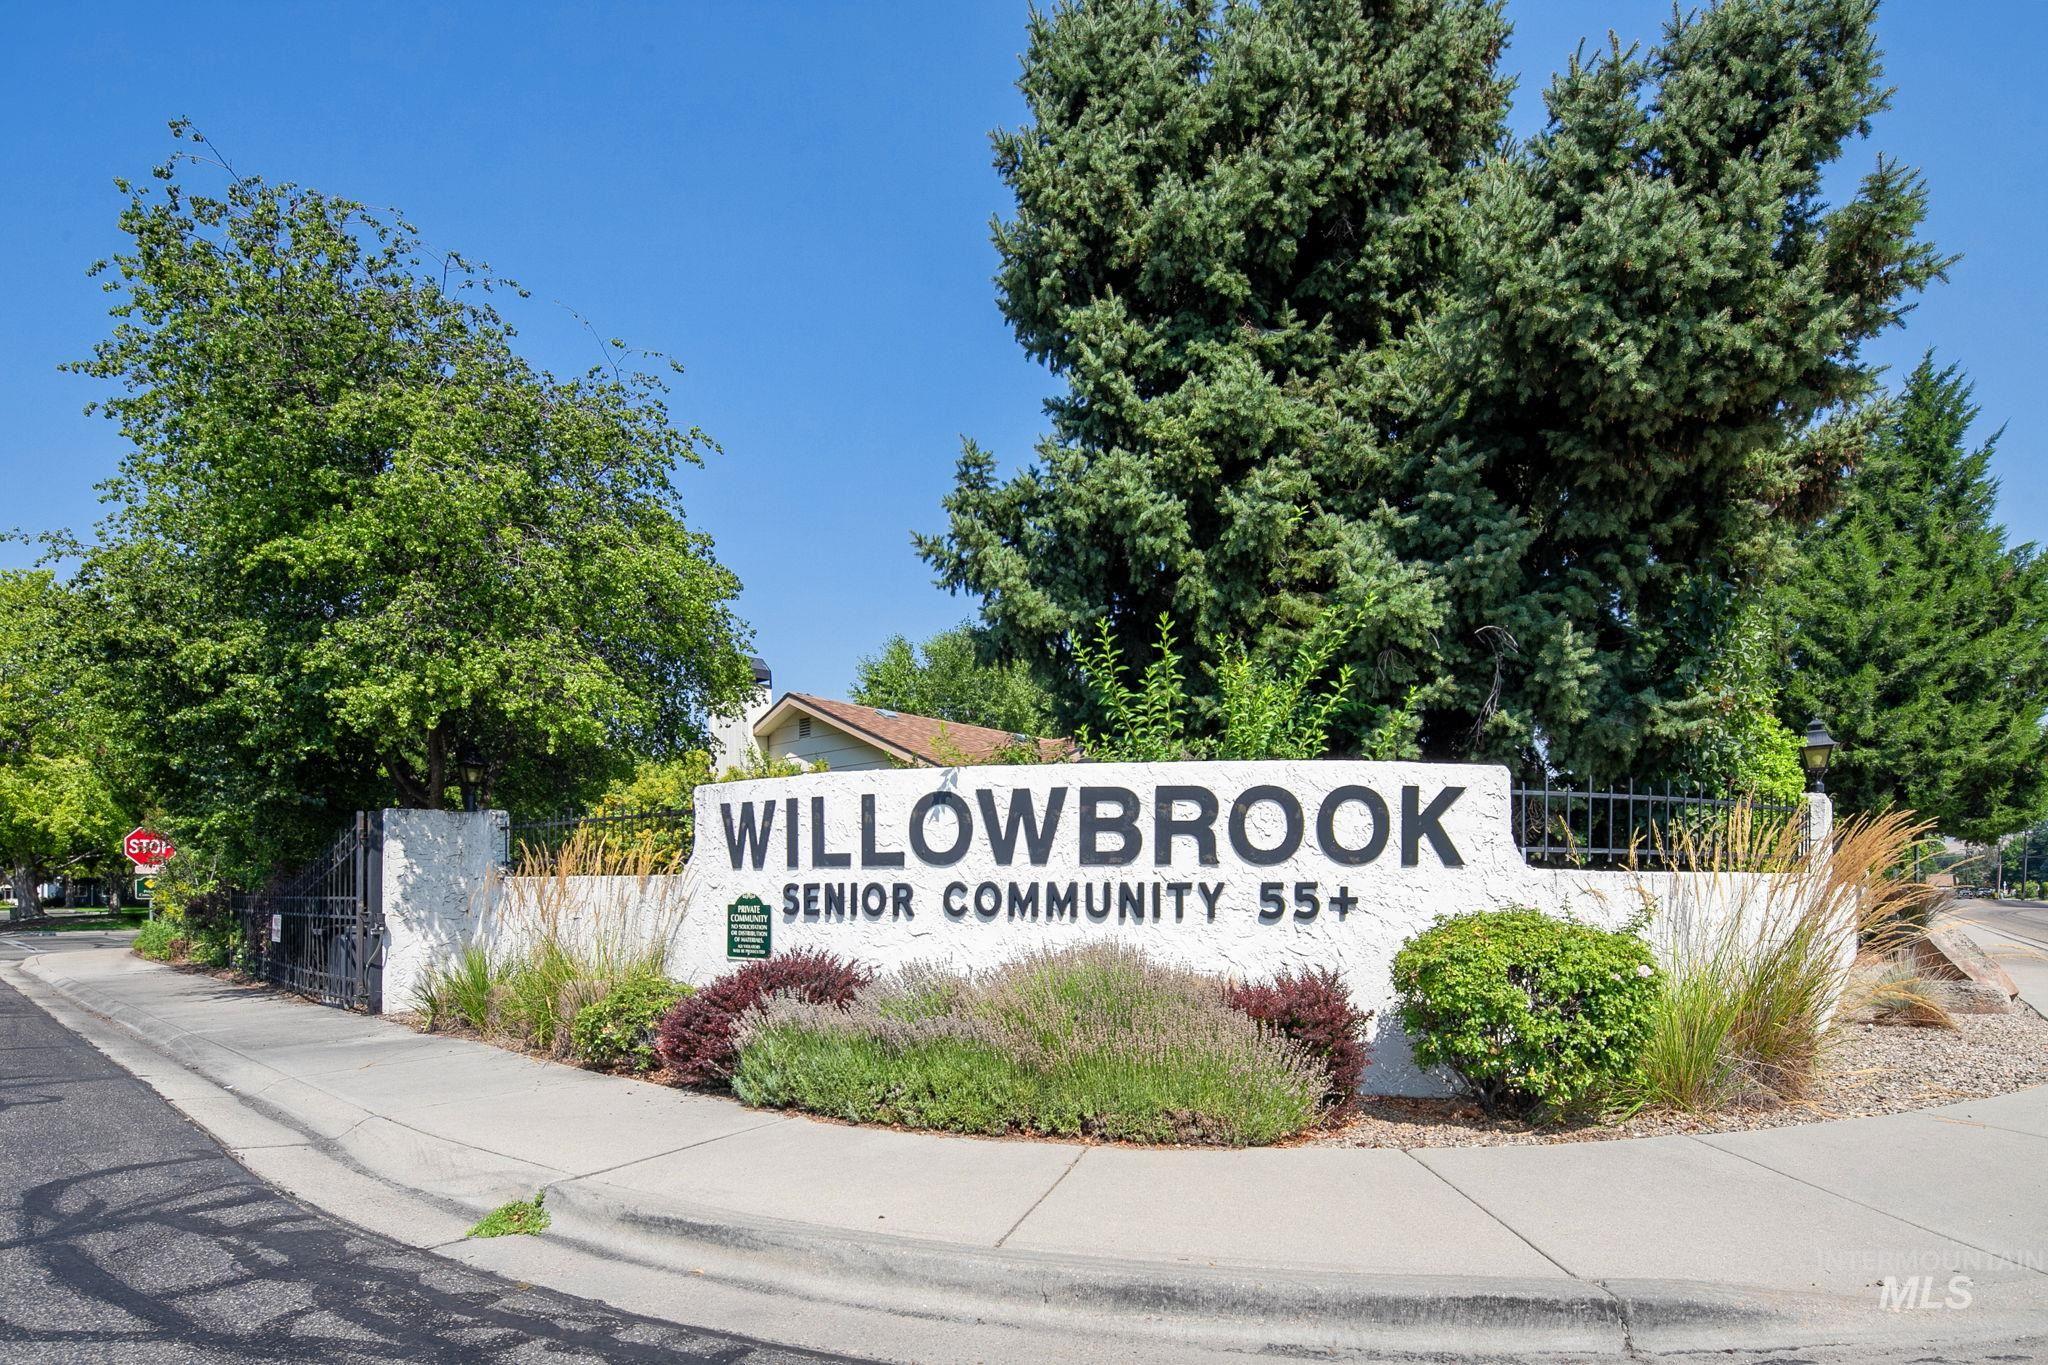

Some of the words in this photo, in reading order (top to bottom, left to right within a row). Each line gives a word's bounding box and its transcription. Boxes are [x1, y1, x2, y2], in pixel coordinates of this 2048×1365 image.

[720, 784, 1467, 871] WILLOWBROOK
[738, 905, 761, 913] PRIVATE
[782, 881, 915, 918] SENIOR
[943, 880, 1225, 920] COMMUNITY
[1258, 881, 1359, 921] 55+
[730, 914, 768, 923] COMMUNITY
